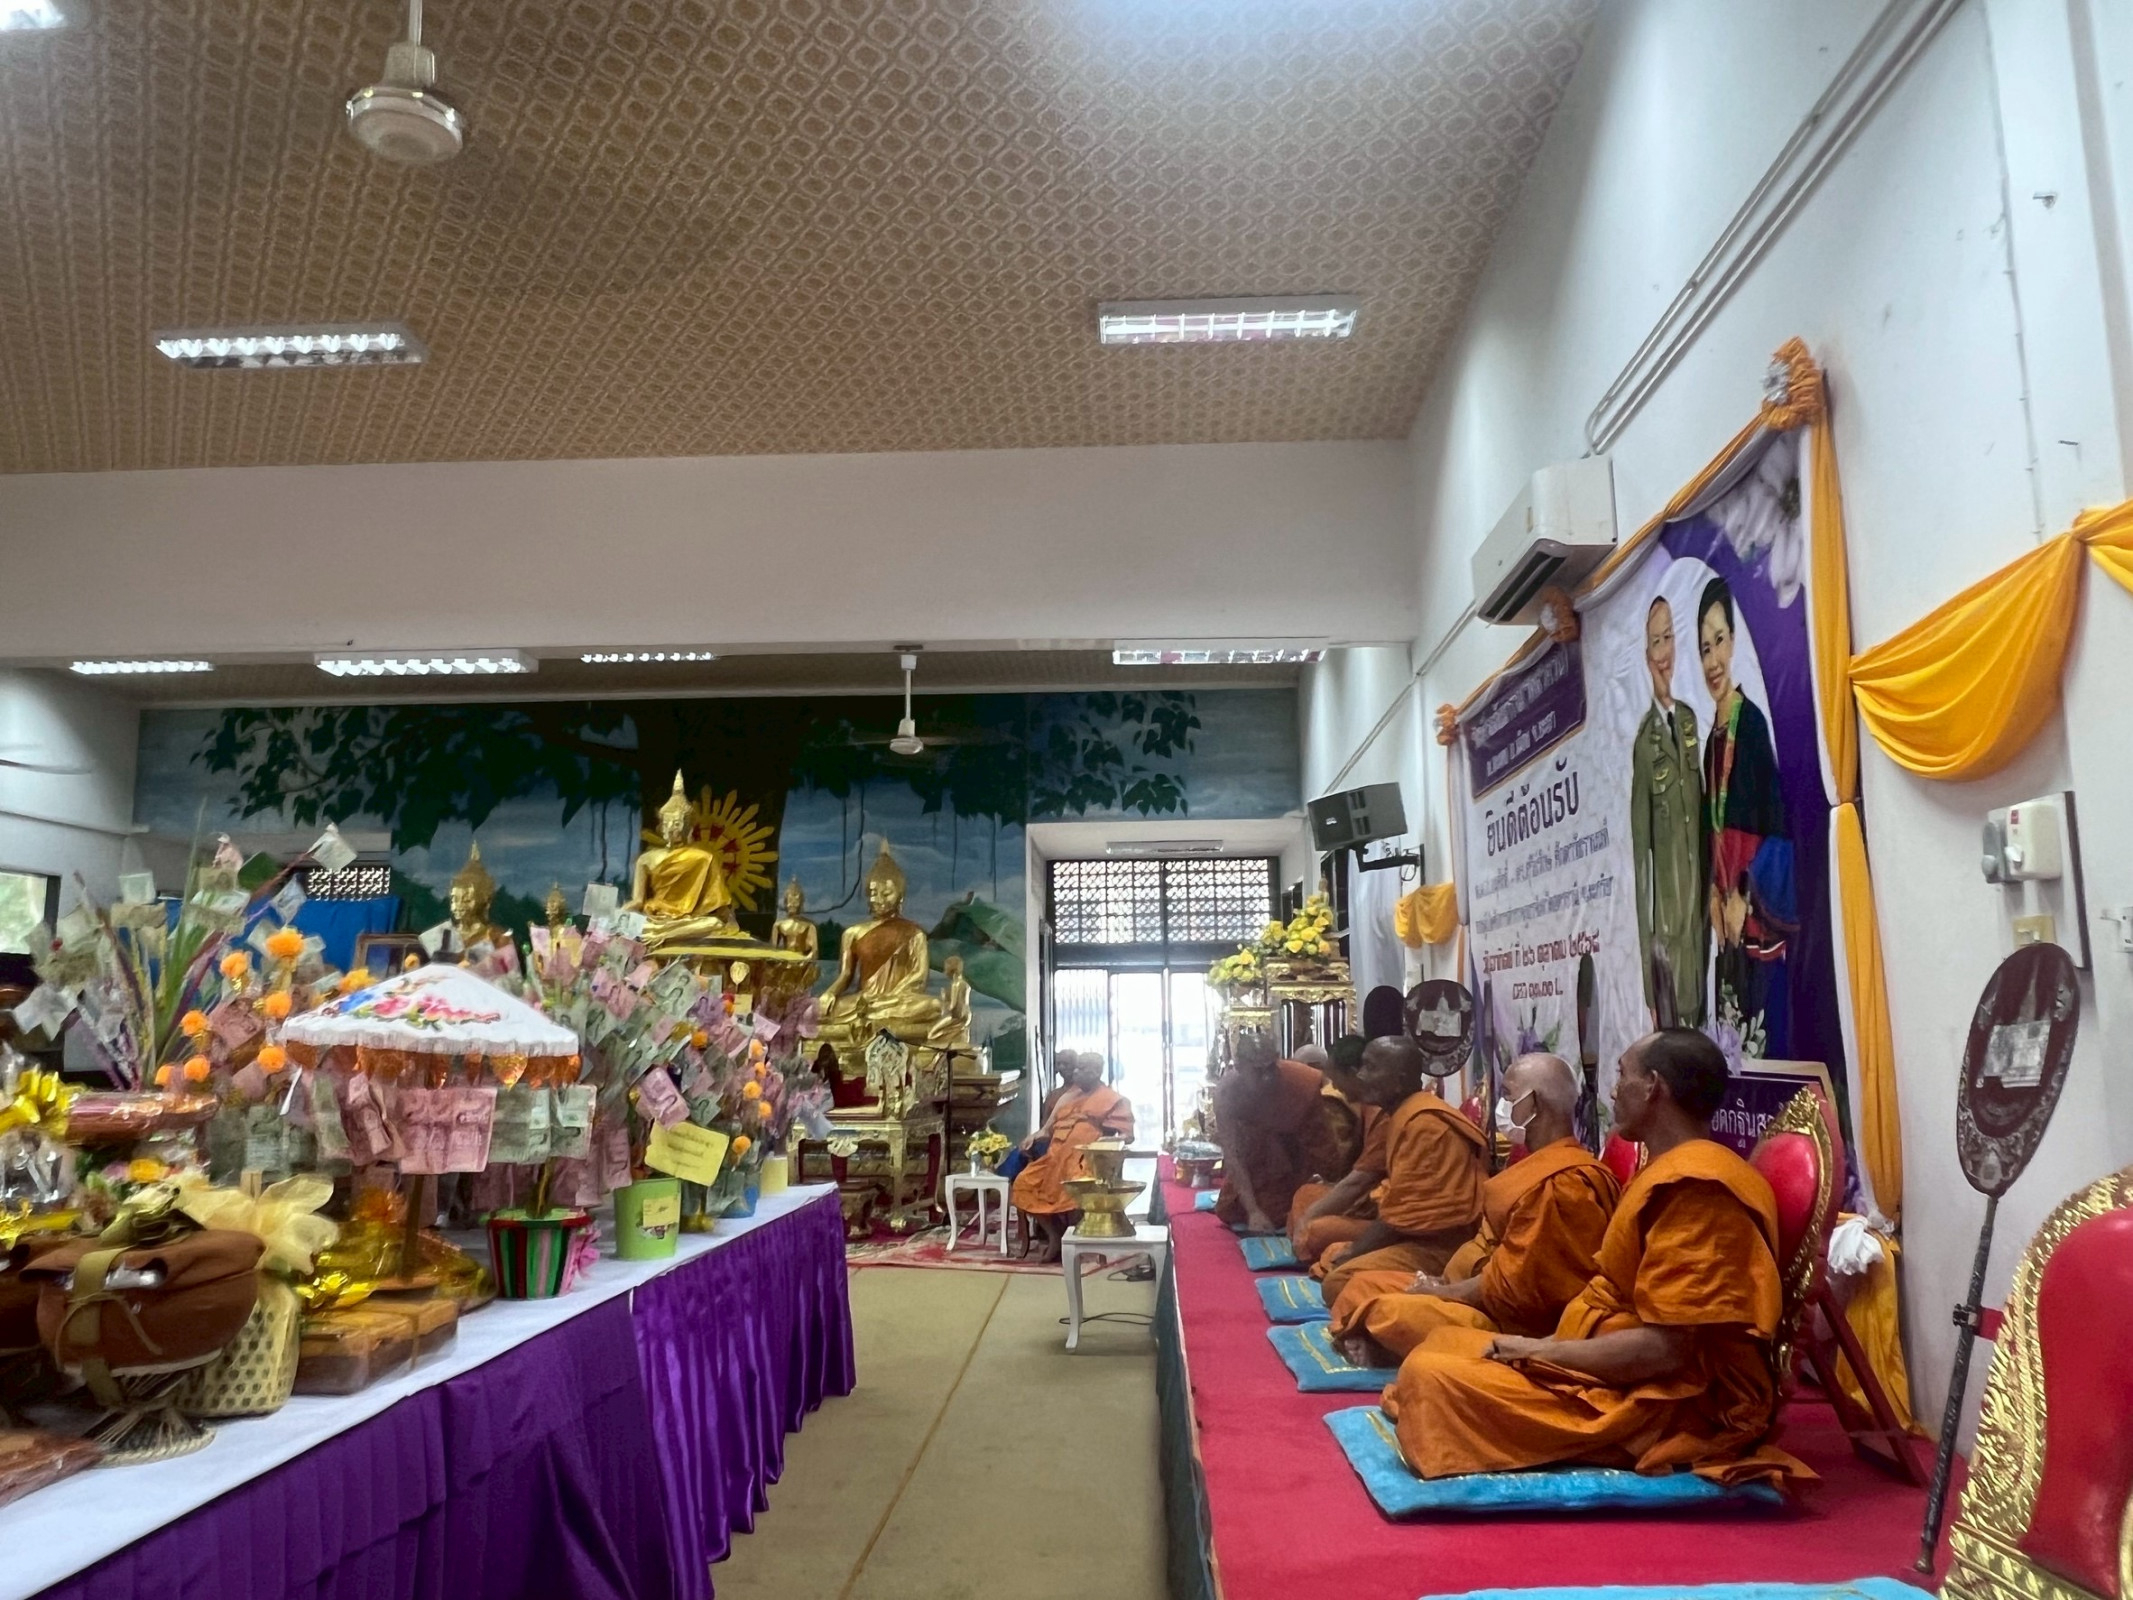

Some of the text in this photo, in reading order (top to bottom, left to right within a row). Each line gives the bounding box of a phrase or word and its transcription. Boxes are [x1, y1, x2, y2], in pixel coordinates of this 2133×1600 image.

[1485, 758, 1580, 856] ยินดีต้อนรับ
